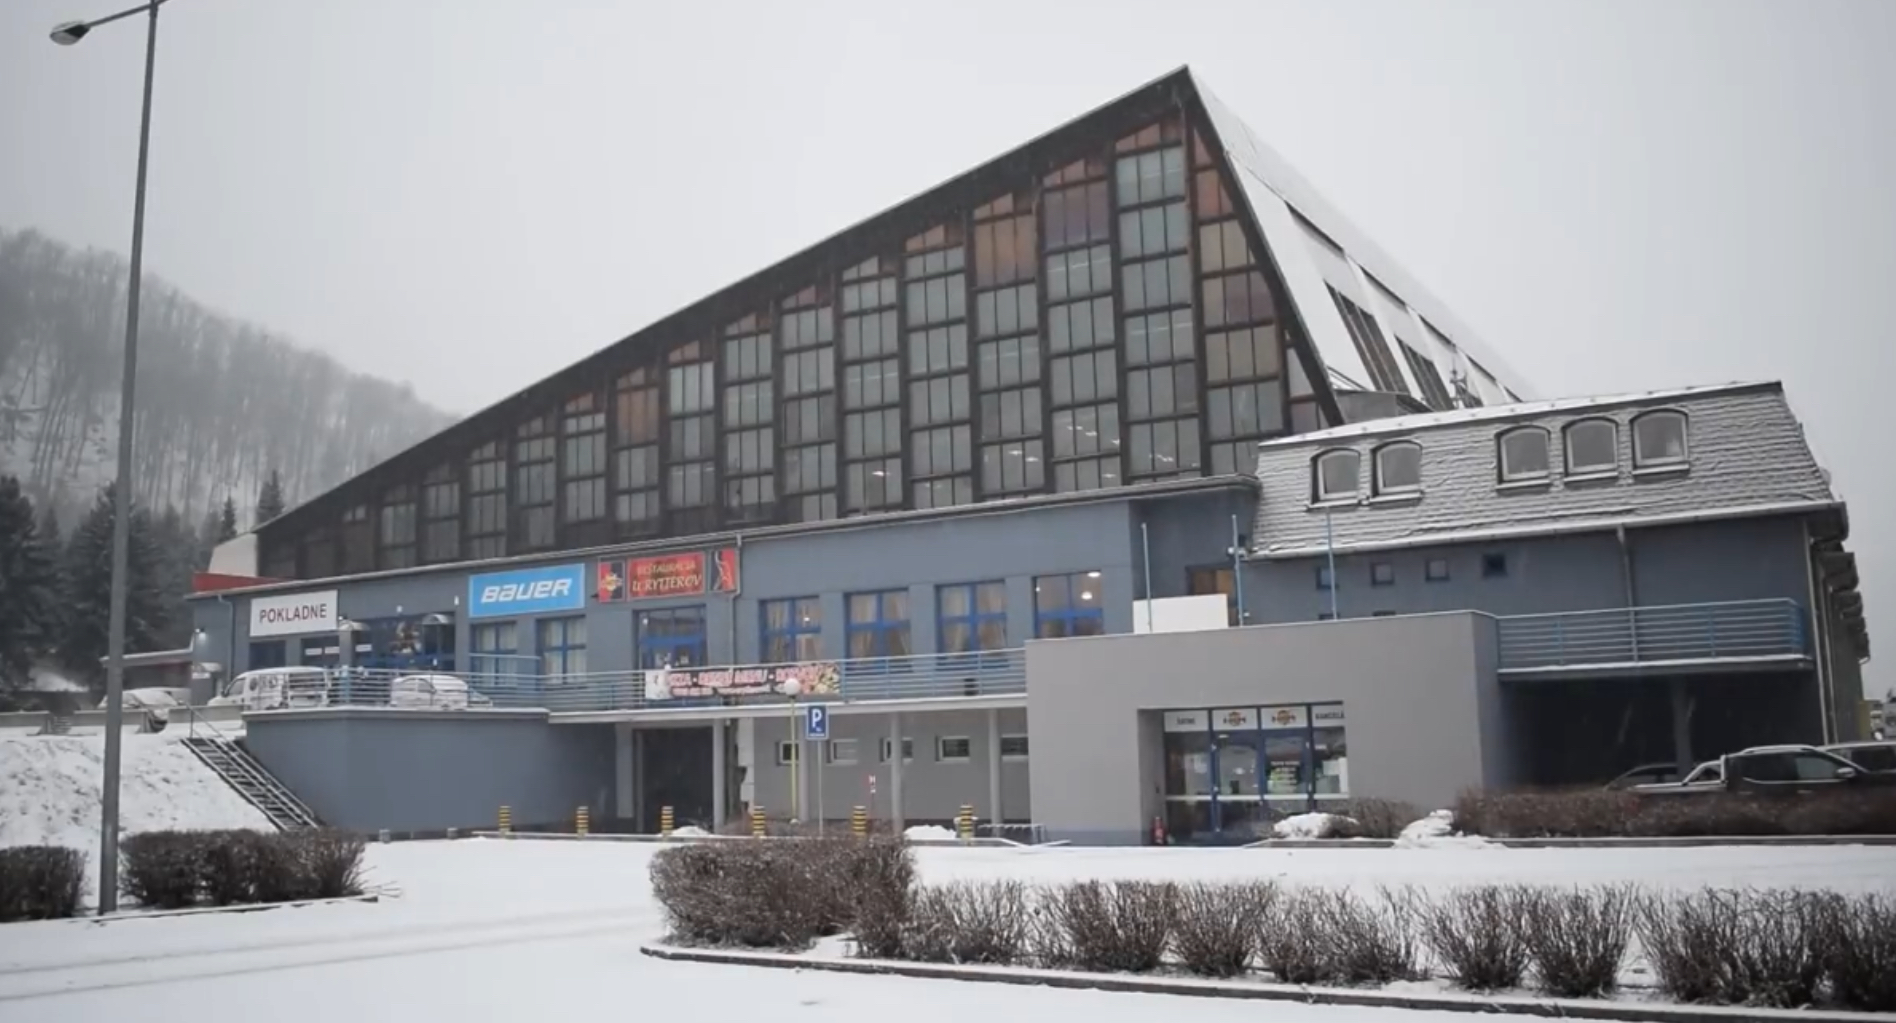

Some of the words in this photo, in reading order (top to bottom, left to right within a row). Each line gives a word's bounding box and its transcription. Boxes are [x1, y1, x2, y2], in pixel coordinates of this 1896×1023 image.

[481, 578, 572, 603] BAUER
[259, 603, 327, 624] POKLADNE
[812, 708, 822, 728] P
